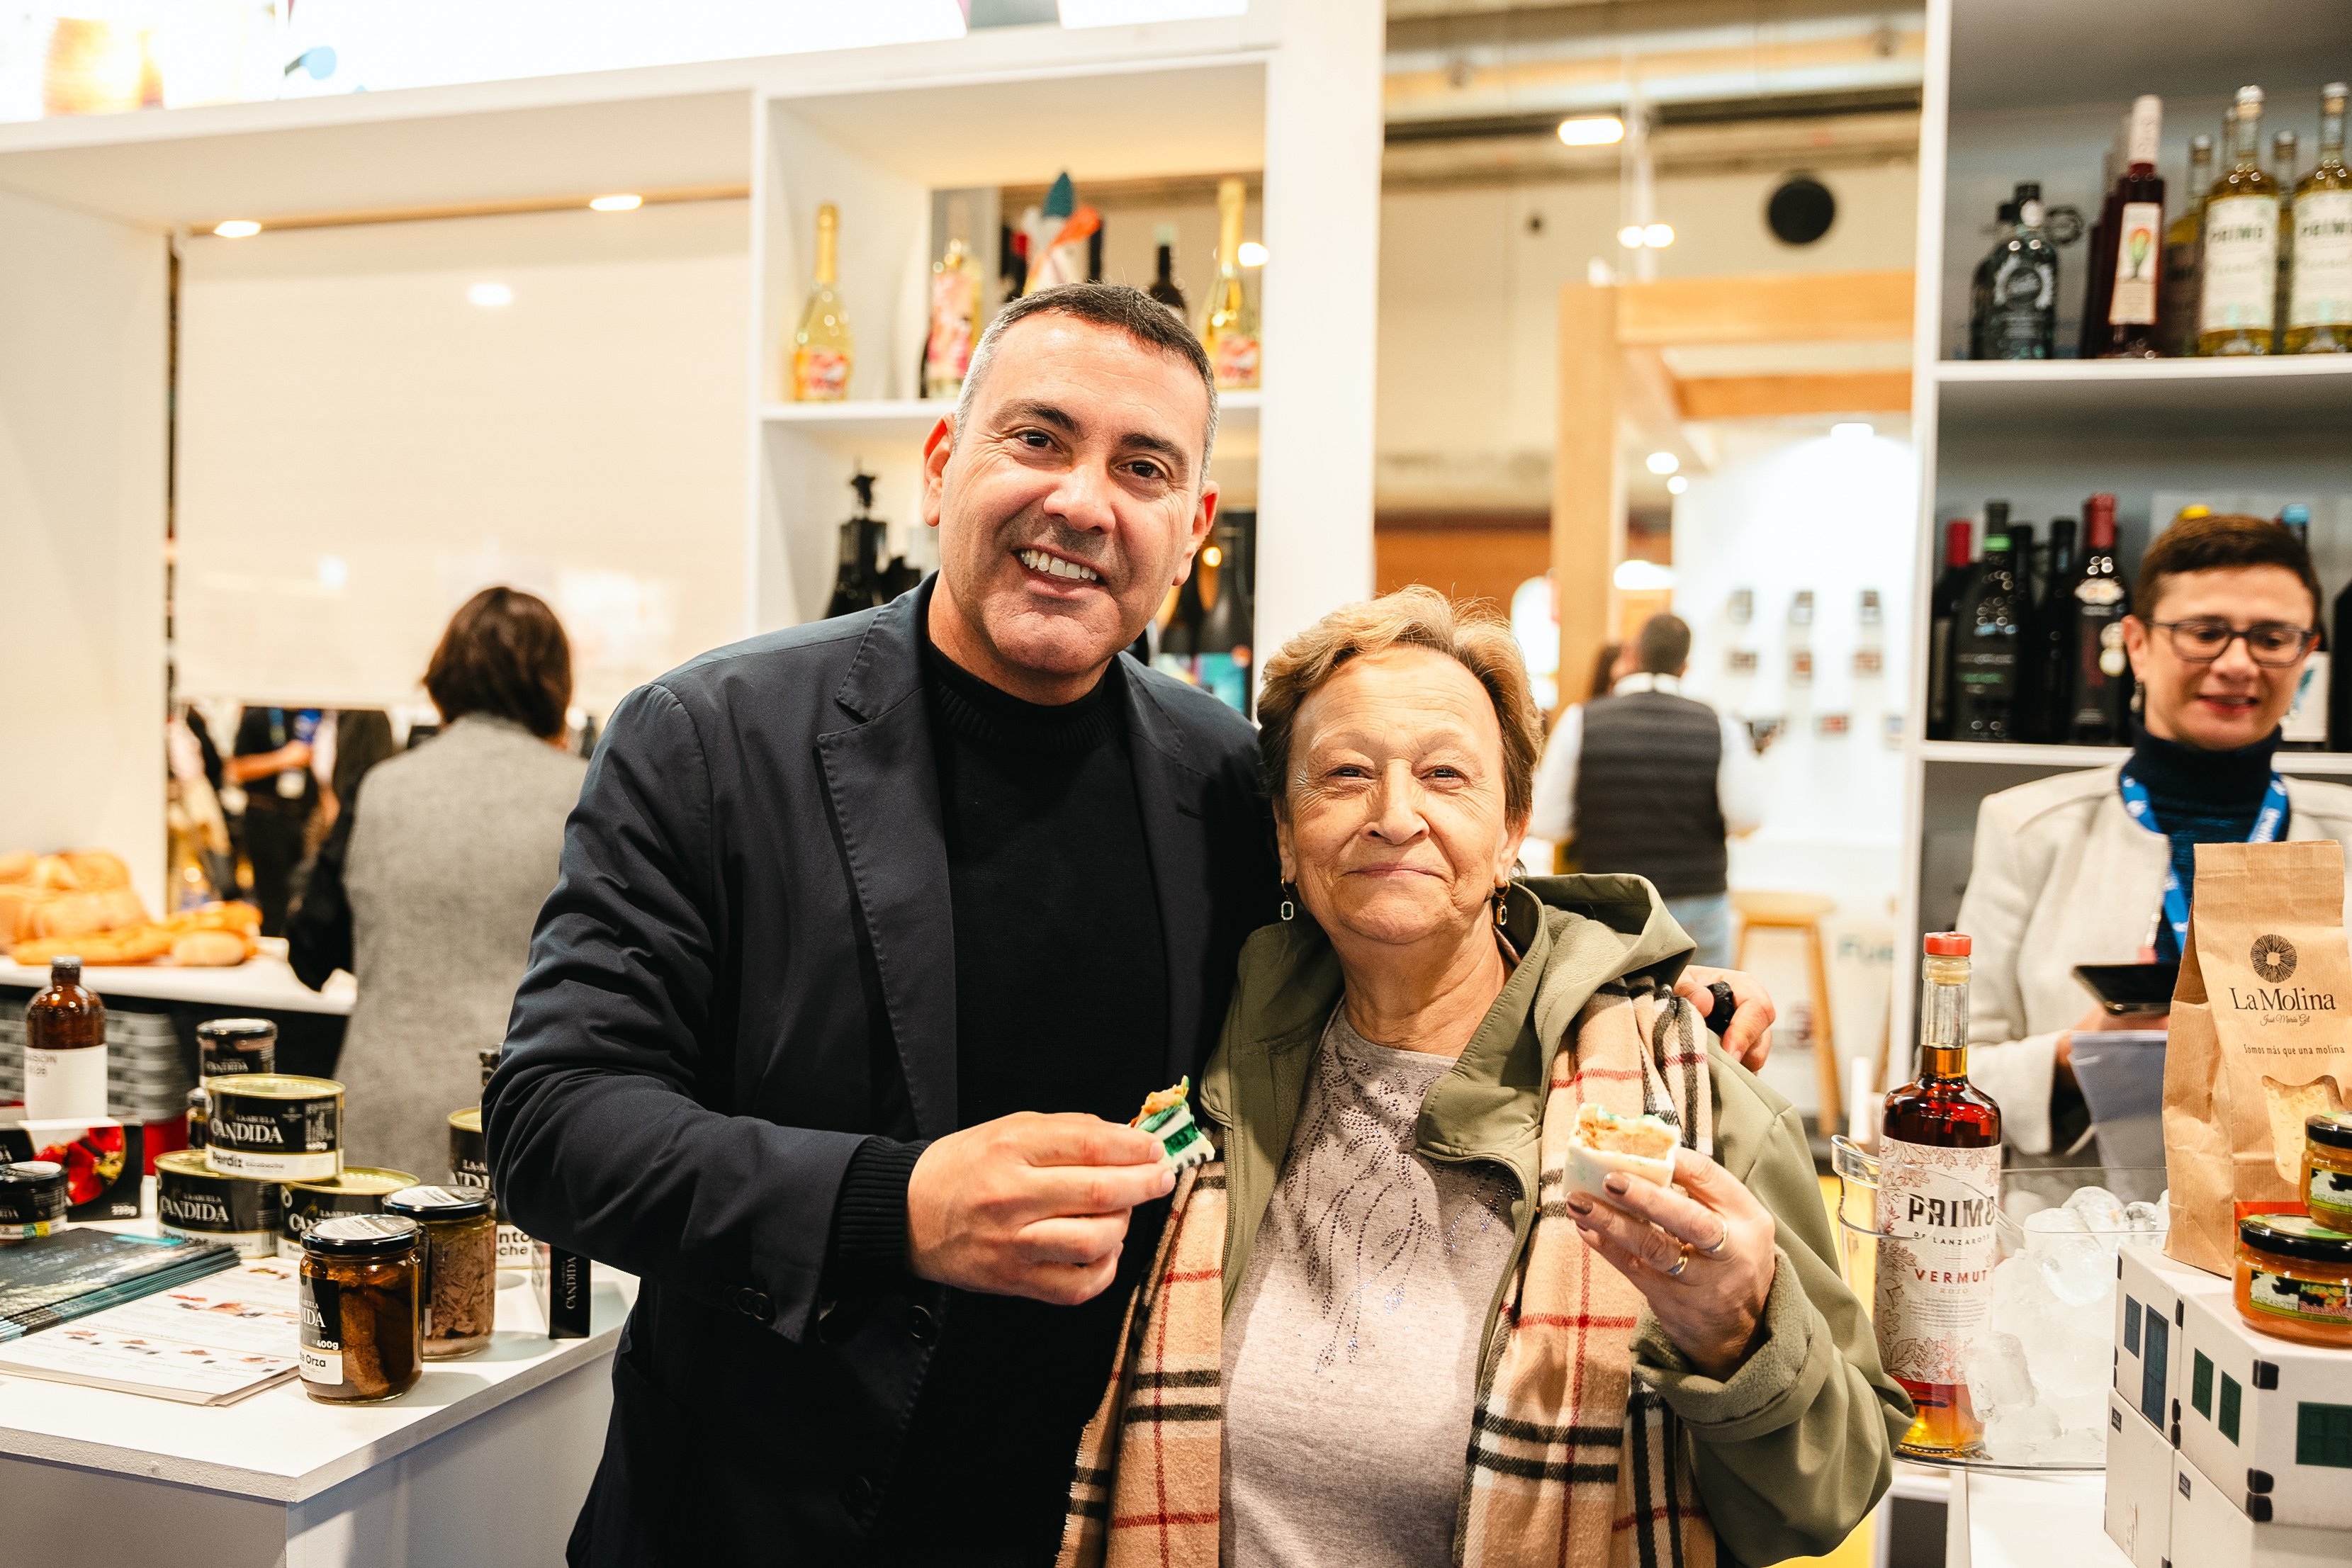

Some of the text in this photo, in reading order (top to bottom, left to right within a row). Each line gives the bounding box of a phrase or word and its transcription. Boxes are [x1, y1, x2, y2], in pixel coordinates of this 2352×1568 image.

[2257, 987, 2337, 1011] Molina
[2244, 1044, 2265, 1054] Somos
[2266, 1045, 2280, 1054] más
[2283, 1048, 2296, 1058] que
[2316, 1044, 2346, 1055] molina
[210, 1117, 284, 1146] CANDIDA
[159, 1195, 230, 1224] CANDIDA
[1908, 1193, 1996, 1228] PRIMO
[1933, 1233, 1990, 1246] LANZAROTE
[566, 1257, 576, 1309] CANDIDA
[1915, 1268, 1987, 1283] VERMUT
[317, 1339, 339, 1350] 400g
[306, 1354, 326, 1368] Orza
